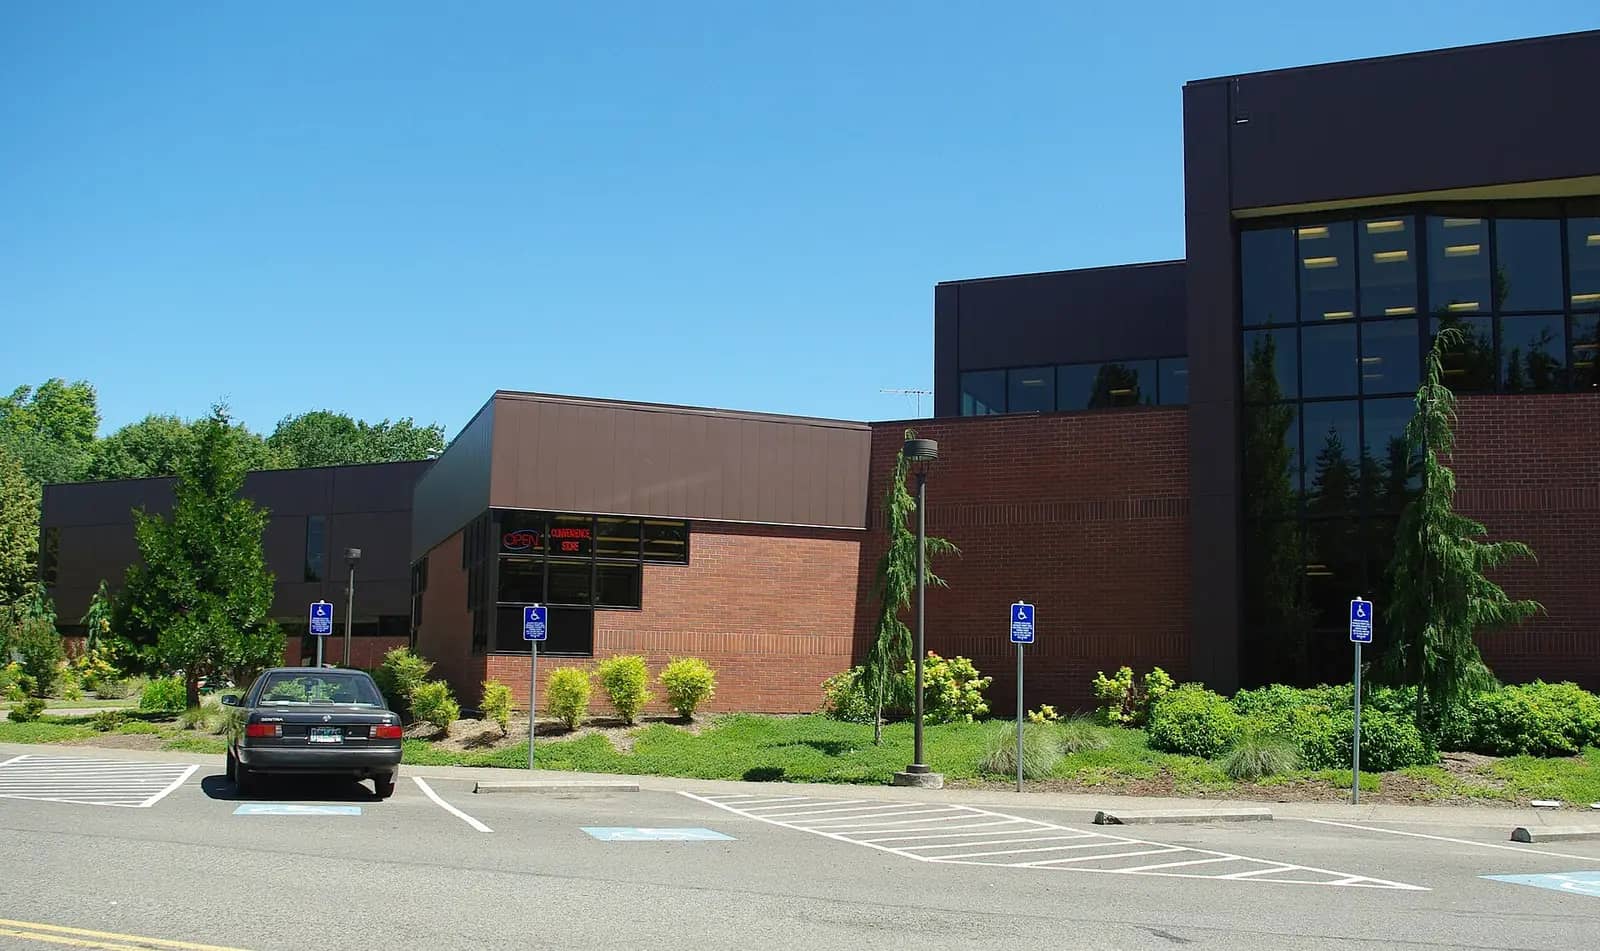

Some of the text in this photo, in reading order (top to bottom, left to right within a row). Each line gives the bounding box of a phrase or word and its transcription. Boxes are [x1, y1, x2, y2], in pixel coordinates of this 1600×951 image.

[550, 527, 591, 538] CONVENIENCE
[503, 533, 539, 547] OPEN
[561, 541, 580, 551] STORE
